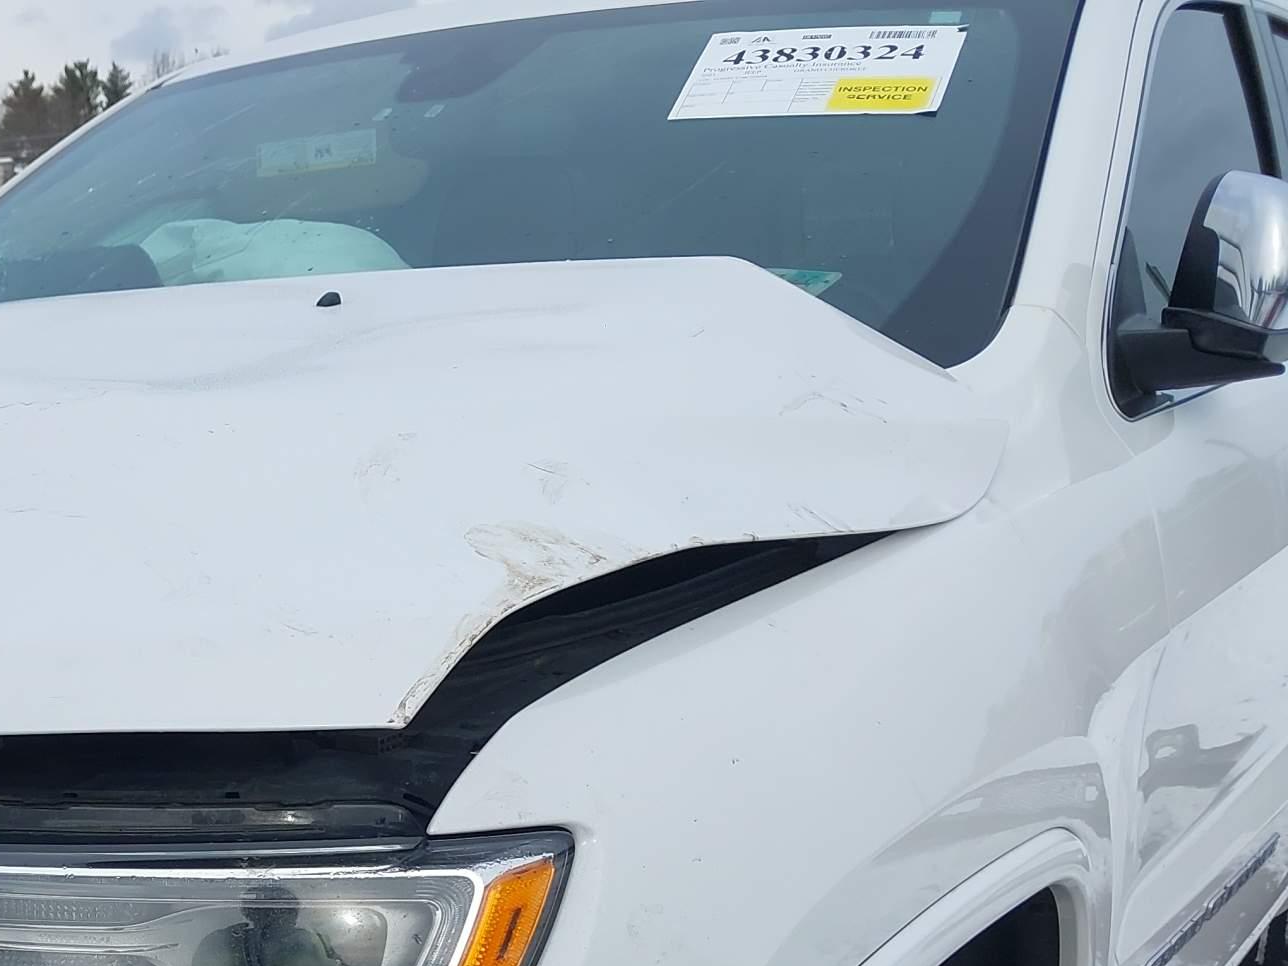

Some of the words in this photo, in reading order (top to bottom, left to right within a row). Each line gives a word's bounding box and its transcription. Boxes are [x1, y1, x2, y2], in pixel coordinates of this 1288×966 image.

[723, 44, 925, 65] 43830324
[837, 85, 929, 93] INSPECTION
[846, 93, 913, 101] SERVICE
